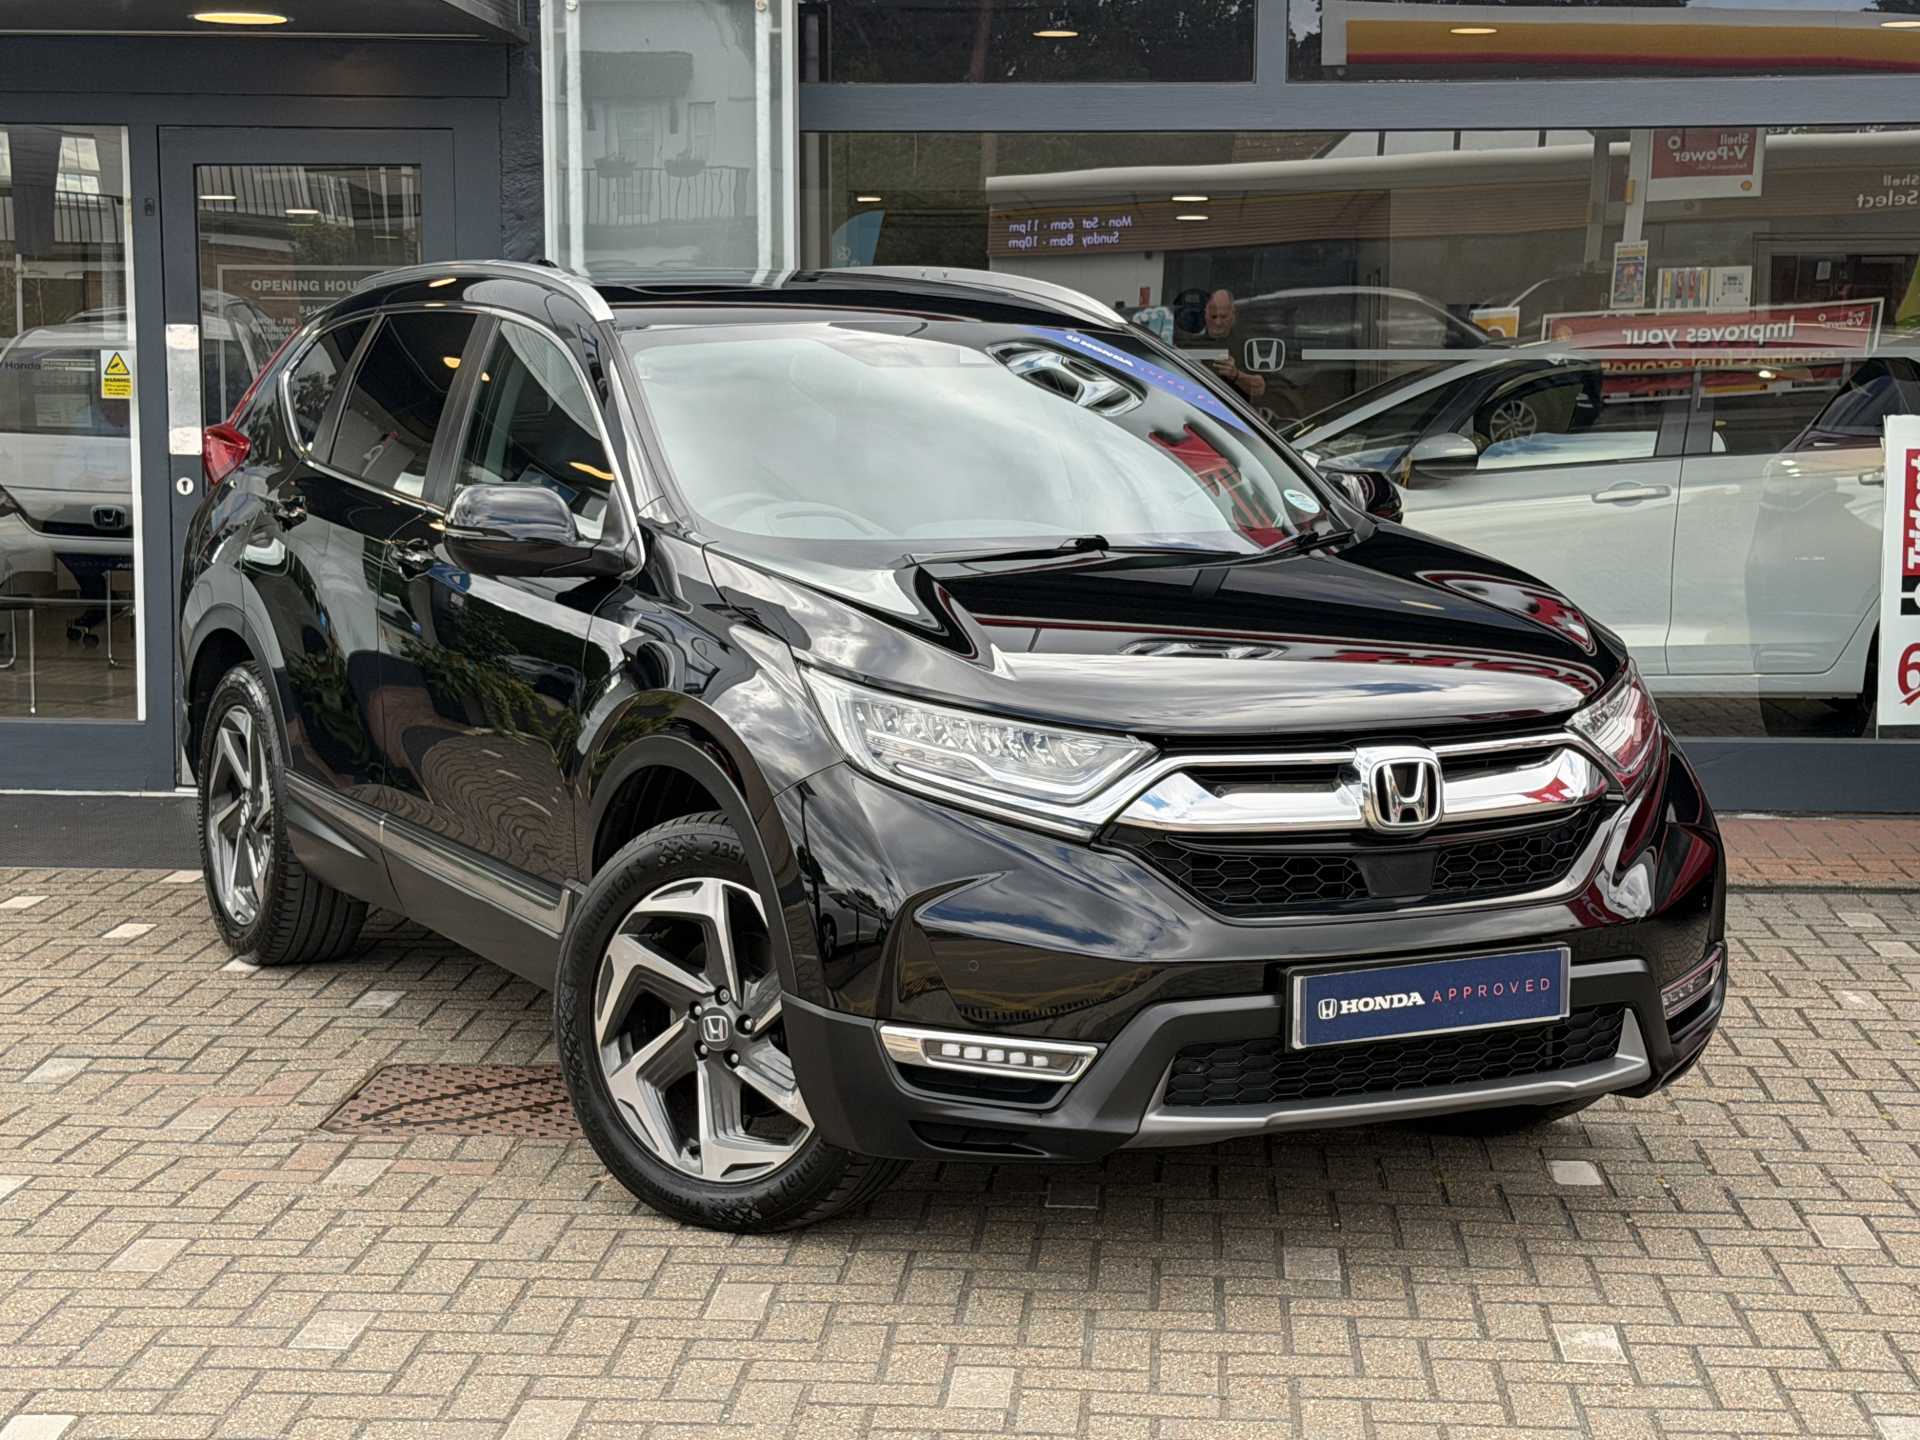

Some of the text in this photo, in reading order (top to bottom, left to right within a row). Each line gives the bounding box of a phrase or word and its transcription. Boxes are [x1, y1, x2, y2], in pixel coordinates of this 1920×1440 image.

[252, 280, 359, 292] OPENING HOU
[4, 361, 41, 370] Honda
[1340, 977, 1551, 1015] HONDA APPROVED
